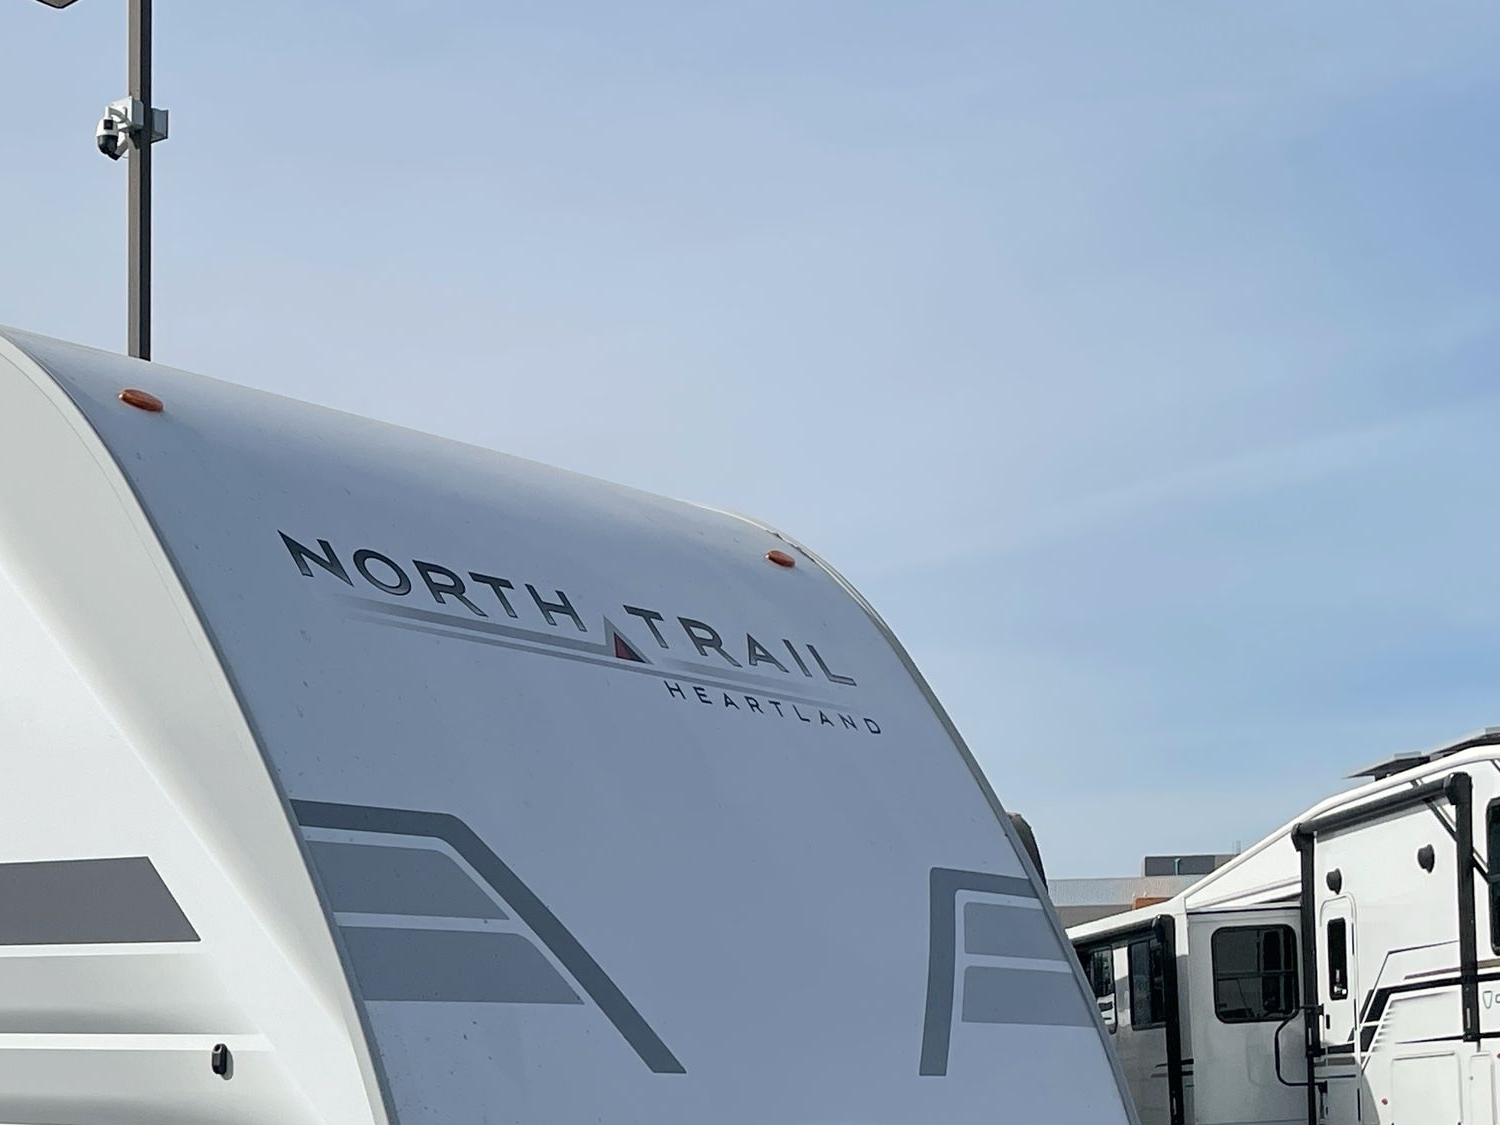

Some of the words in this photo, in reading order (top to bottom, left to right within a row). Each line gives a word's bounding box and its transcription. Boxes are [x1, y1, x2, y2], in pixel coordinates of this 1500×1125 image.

[277, 529, 589, 633] NORTH
[623, 604, 857, 687] TRAIL
[664, 680, 883, 735] HEARTLAND
